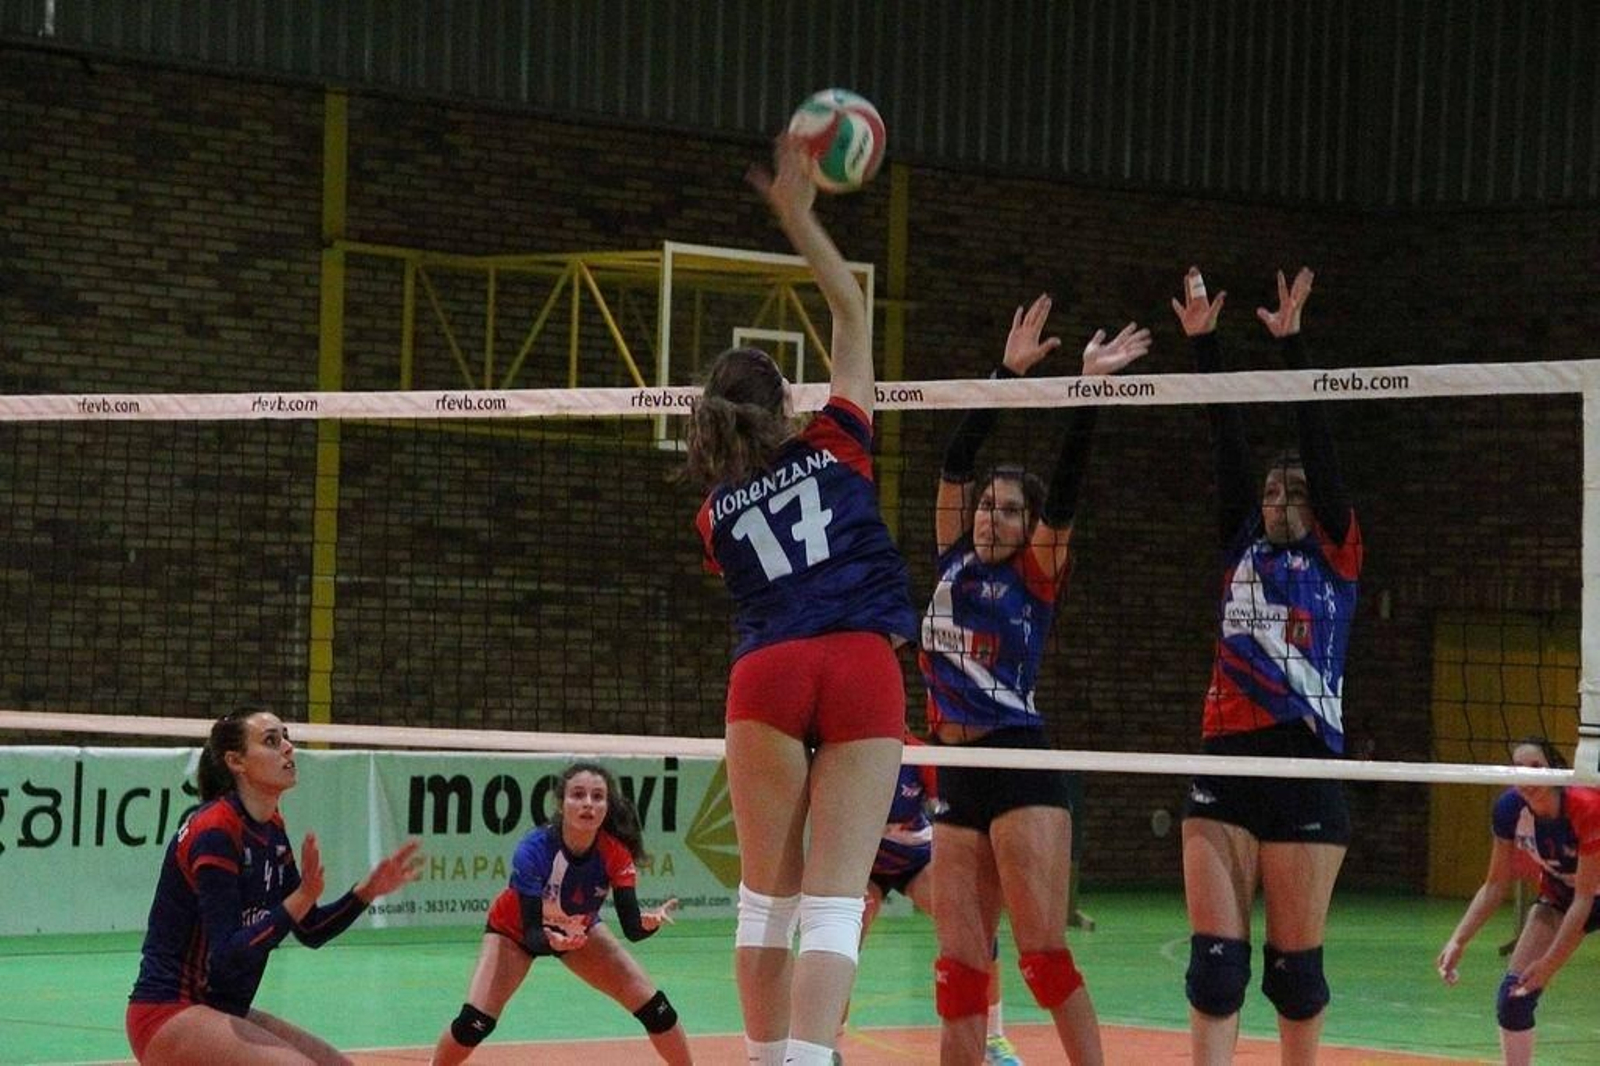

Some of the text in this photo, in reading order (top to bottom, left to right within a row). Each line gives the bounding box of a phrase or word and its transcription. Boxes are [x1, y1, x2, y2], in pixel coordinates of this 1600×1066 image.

[1067, 380, 1156, 399] rfevb.com
[1313, 372, 1409, 393] rfevb.com
[436, 394, 506, 411] rfevb.com
[632, 390, 703, 407] rfevb.co
[875, 385, 923, 403] b.com
[78, 397, 139, 413] rfevb.com
[252, 396, 318, 412] rfevb.com
[731, 476, 832, 581] 17
[408, 757, 678, 836] mocvi
[459, 898, 490, 912] VIGO
